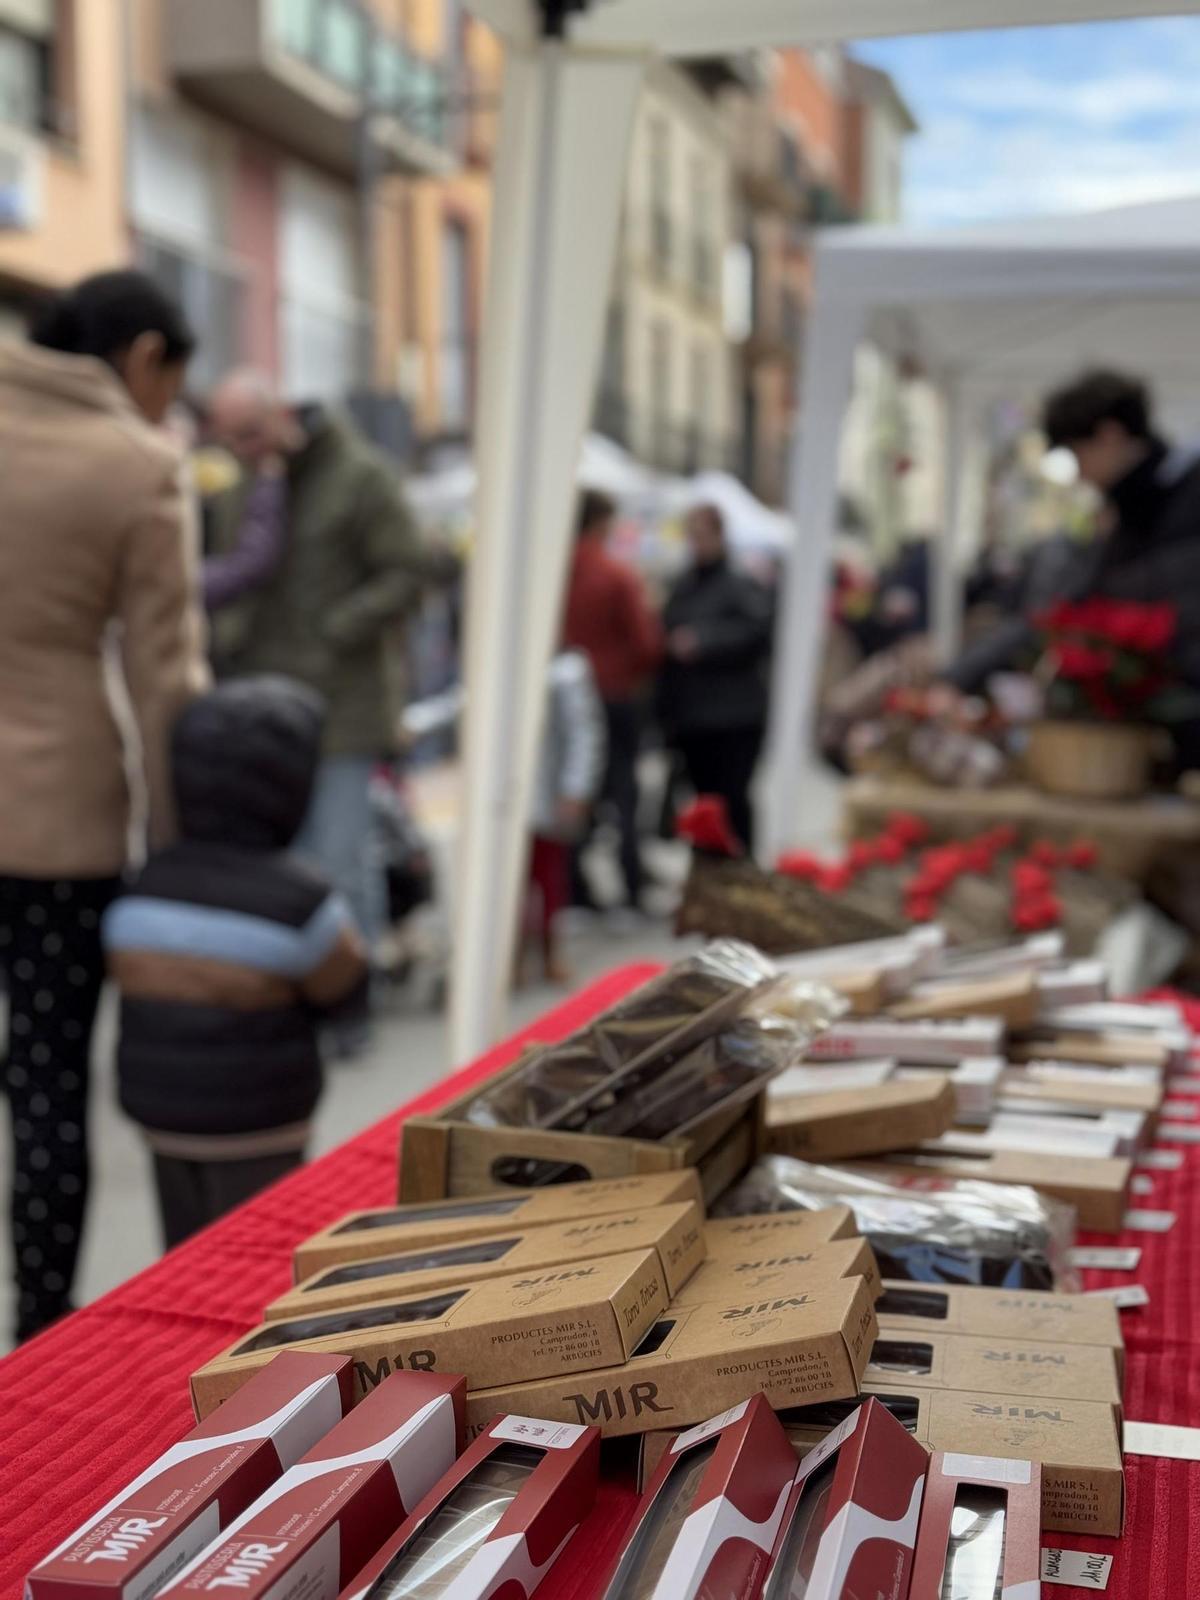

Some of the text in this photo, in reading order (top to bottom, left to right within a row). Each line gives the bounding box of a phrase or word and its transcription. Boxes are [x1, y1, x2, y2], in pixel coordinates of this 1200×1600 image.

[717, 1294, 816, 1319] MIR
[491, 1319, 597, 1345] PRODUCTES MIR S.L.
[716, 1351, 827, 1376] PRODUCTES MIR S.L.
[562, 1381, 674, 1425] MIR
[962, 1402, 1074, 1423] MIR
[1054, 1480, 1077, 1489] MIR
[1079, 1481, 1098, 1492] S.L.
[62, 1516, 125, 1562] PASTISSERIA
[83, 1516, 169, 1565] MIR
[184, 1541, 245, 1589] PASTISSERIA
[205, 1541, 289, 1591] MIR
